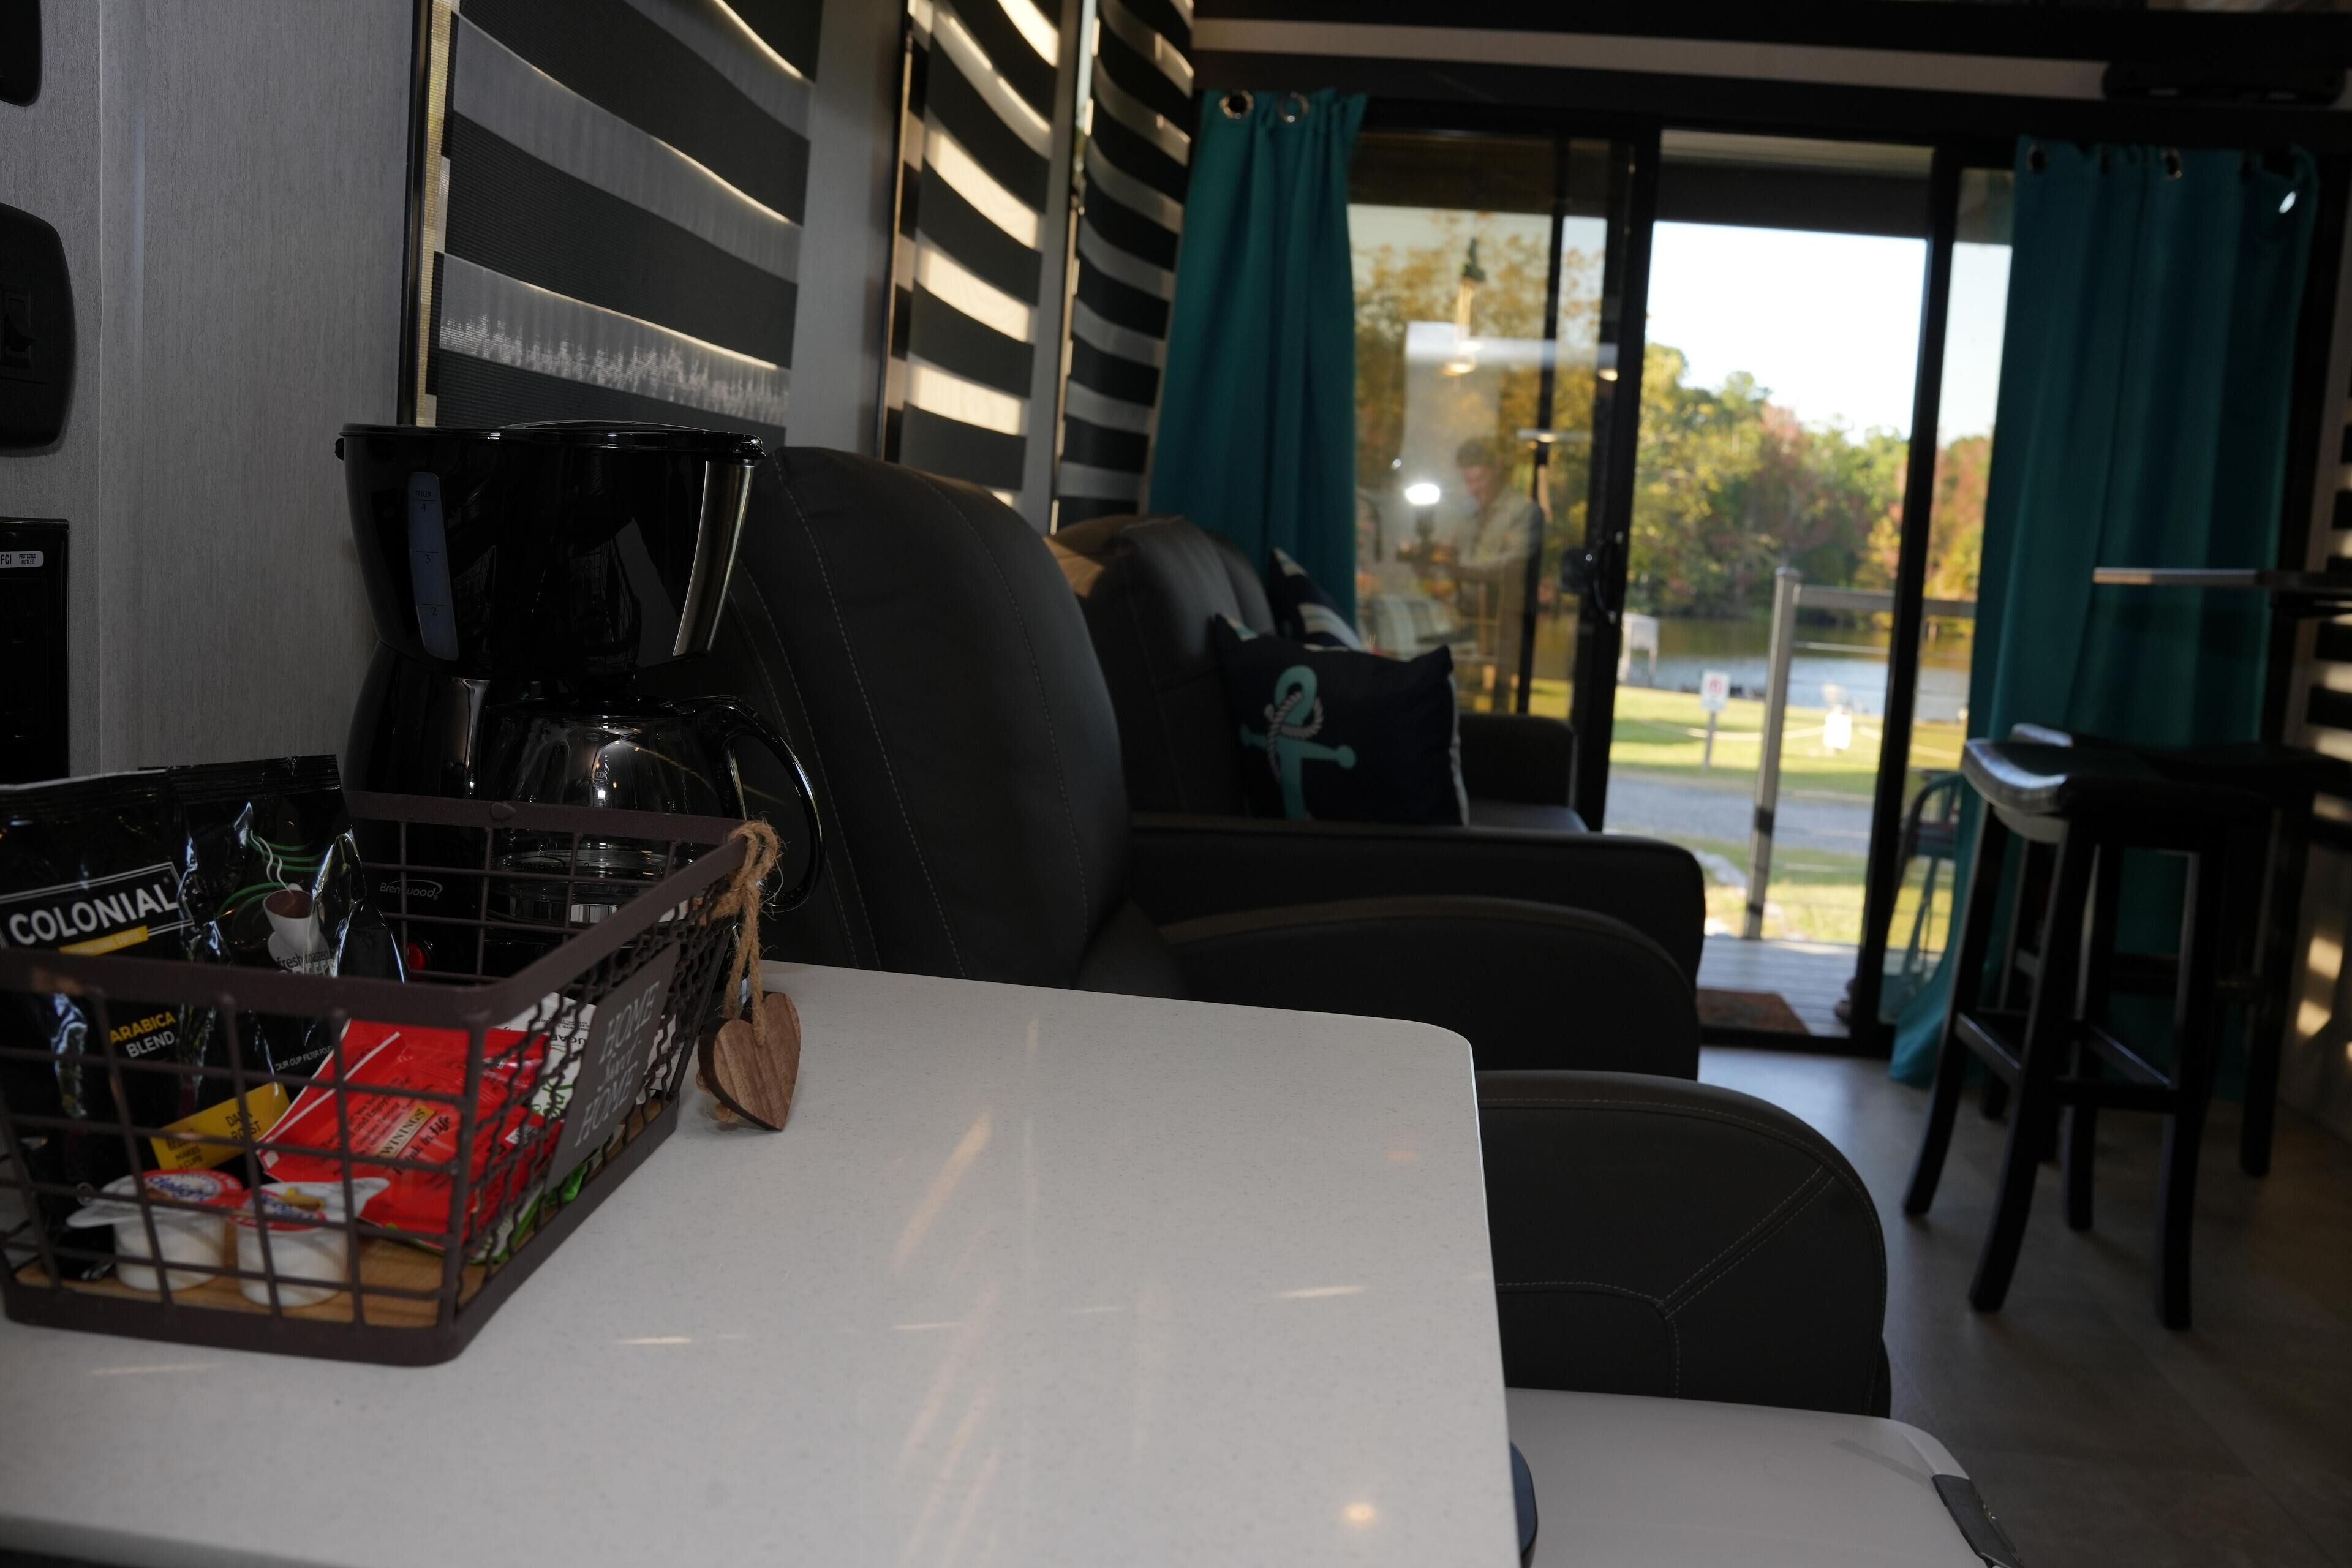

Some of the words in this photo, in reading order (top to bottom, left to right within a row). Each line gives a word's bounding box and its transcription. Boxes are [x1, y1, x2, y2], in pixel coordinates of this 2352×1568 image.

[421, 503, 427, 511] 4
[425, 554, 431, 564] 3
[431, 607, 437, 616] 2
[380, 882, 437, 897] Brenwood
[9, 883, 179, 946] COLONIAL
[277, 952, 303, 968] fresh
[109, 1010, 176, 1045] ARABICA
[598, 981, 660, 1065] HOME
[125, 1030, 175, 1058] BLEND
[303, 1050, 319, 1061] FILTER
[575, 1060, 638, 1148] HOME
[230, 1120, 262, 1141] ROST
[375, 1107, 426, 1158] WININGS
